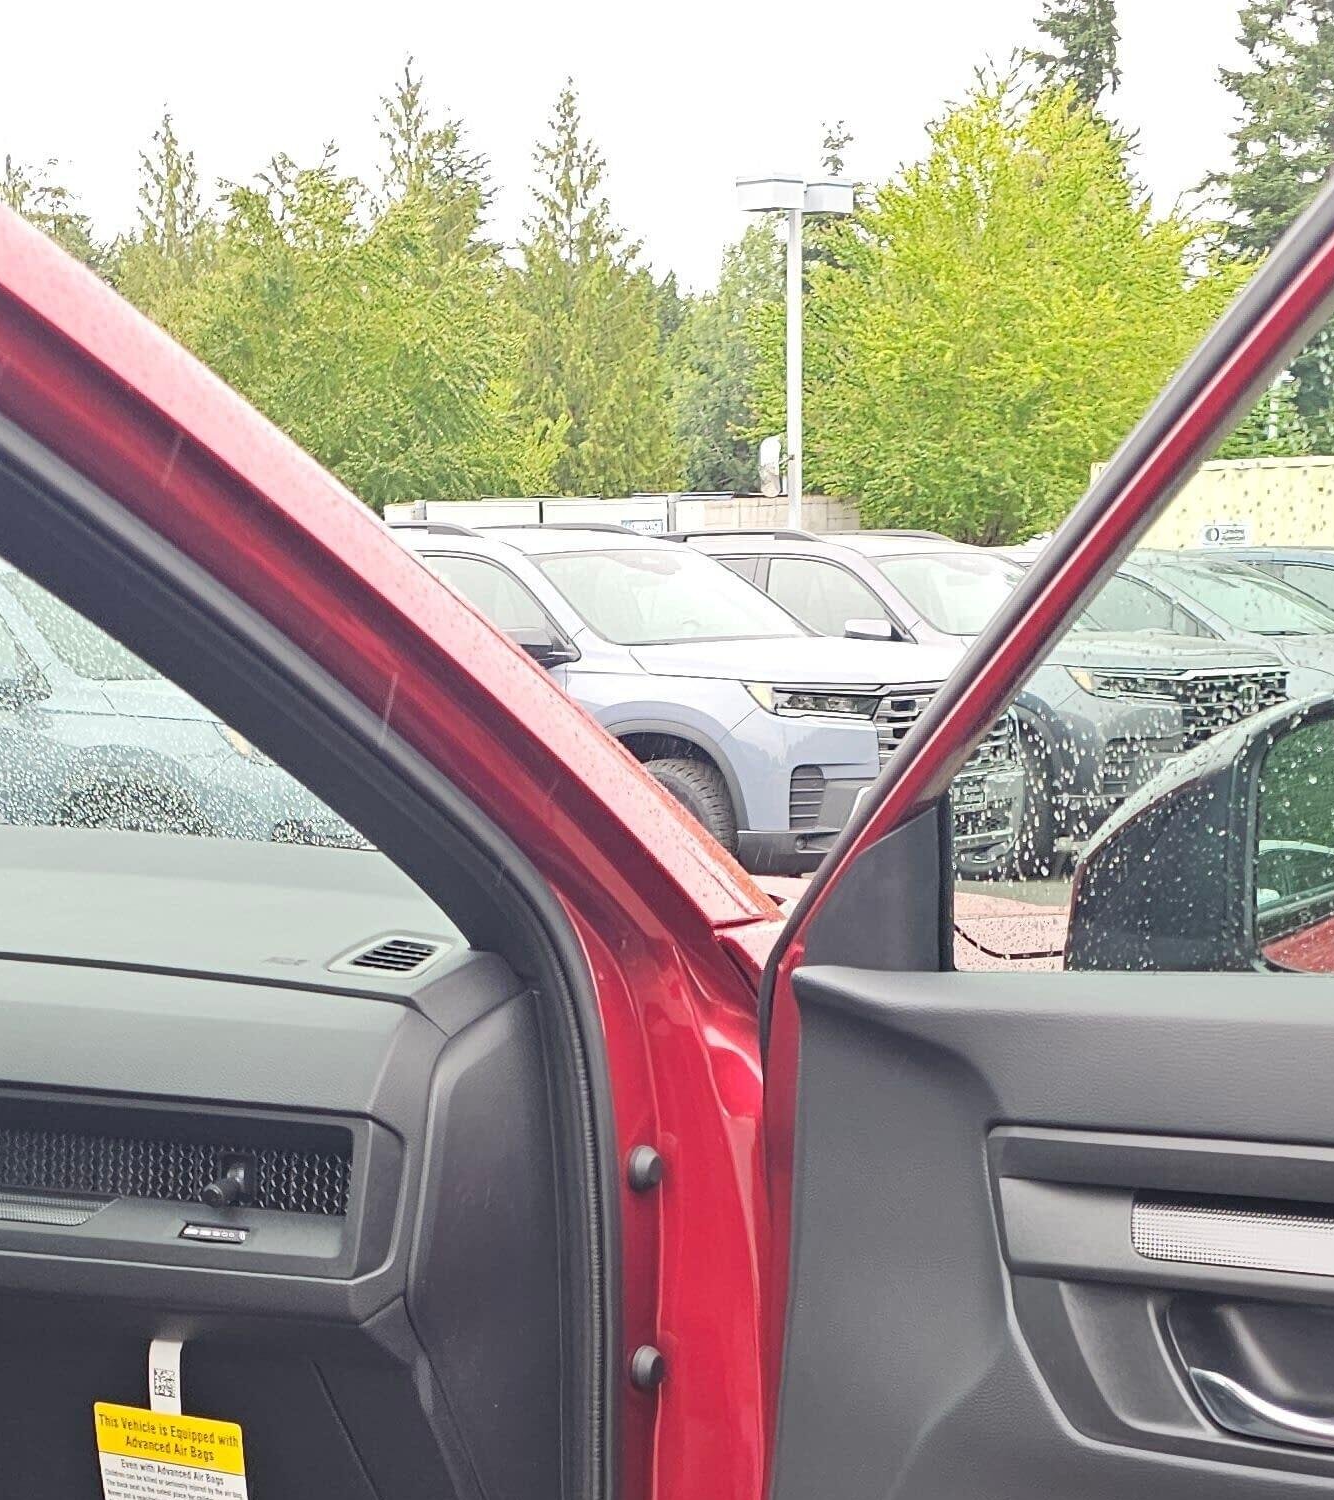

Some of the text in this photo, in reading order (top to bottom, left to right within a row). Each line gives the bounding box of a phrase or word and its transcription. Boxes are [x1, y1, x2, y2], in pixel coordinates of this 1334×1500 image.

[99, 1413, 239, 1448] This Vehicle is Equipped with
[125, 1435, 215, 1462] Advanced Air Bags
[157, 1465, 192, 1479] Advanced
